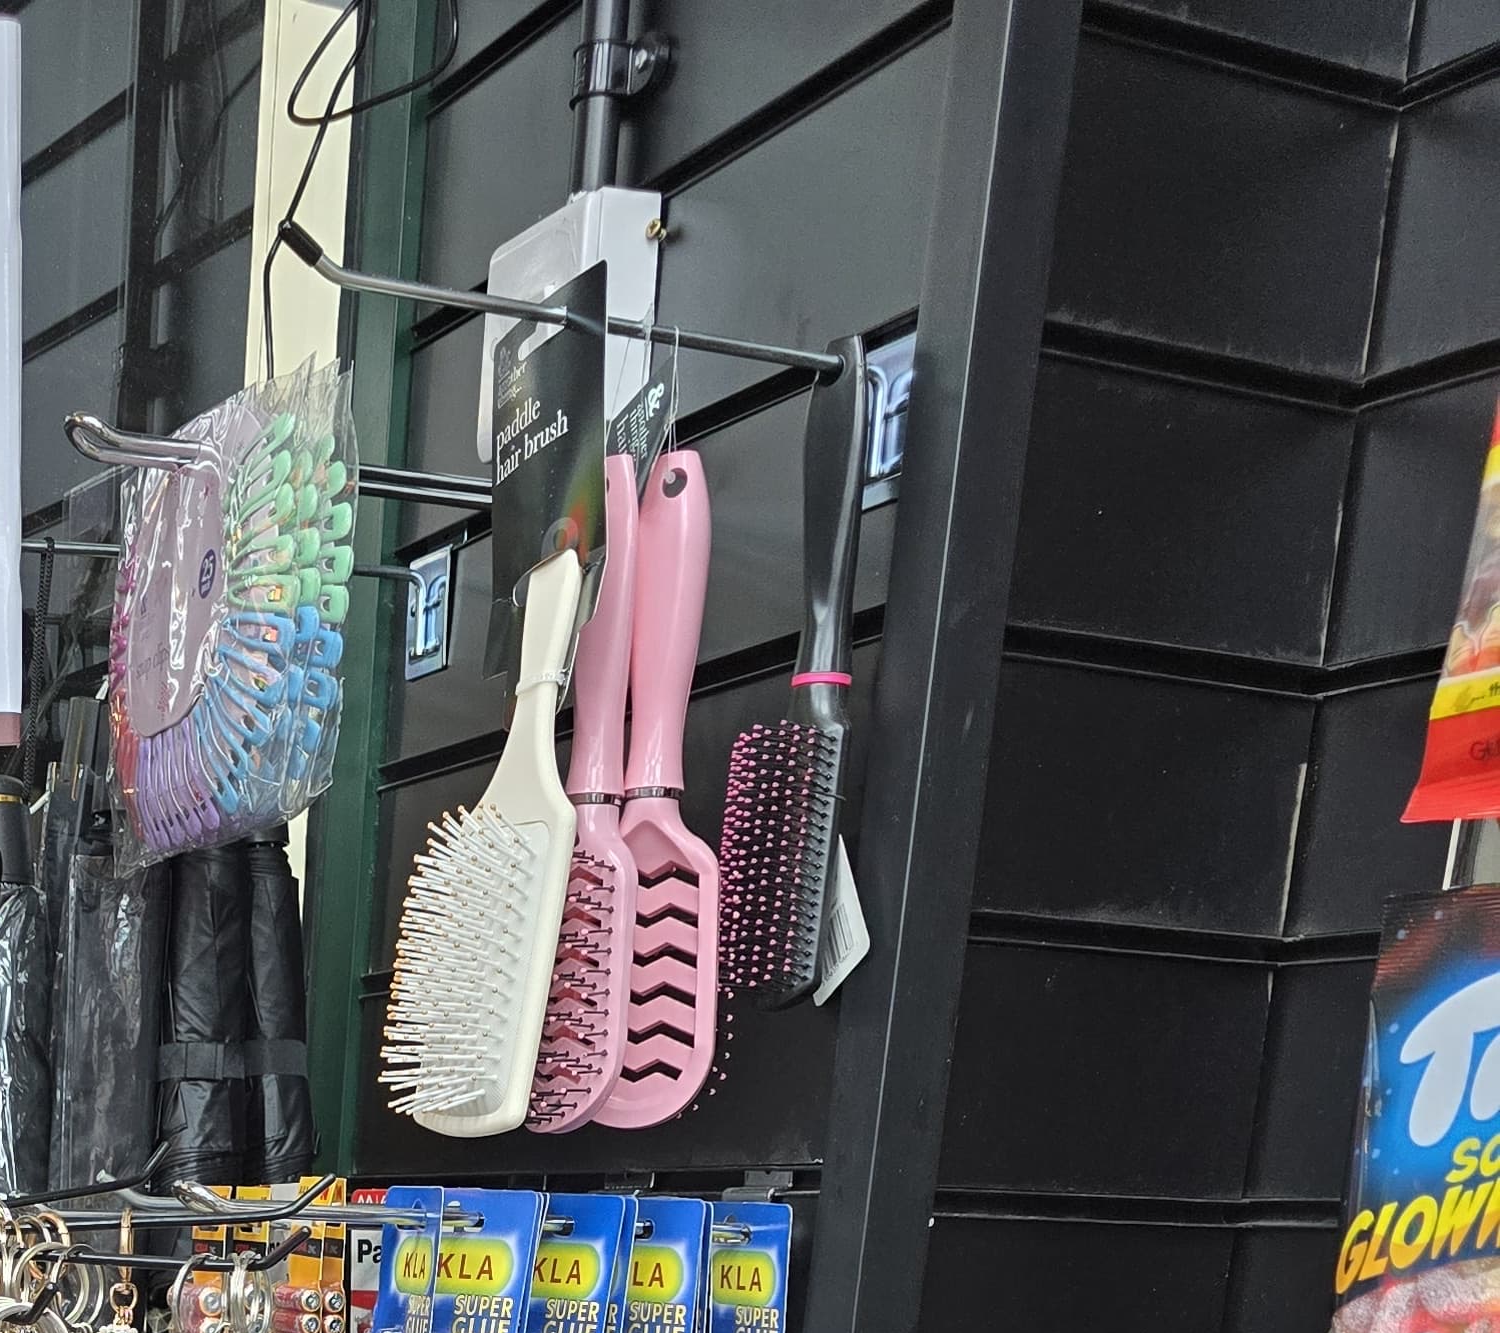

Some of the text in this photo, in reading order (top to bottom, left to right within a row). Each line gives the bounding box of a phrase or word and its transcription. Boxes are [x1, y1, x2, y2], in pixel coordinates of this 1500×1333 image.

[495, 397, 541, 452] paddle
[495, 408, 569, 487] hair brush
[403, 1252, 426, 1280] KLA
[437, 1251, 494, 1281] KLA
[532, 1257, 582, 1286] KLA
[631, 1261, 665, 1289] LA
[719, 1264, 762, 1292] KLA
[407, 1295, 431, 1317] SUPER
[453, 1294, 515, 1319] SUPER
[544, 1298, 600, 1322] SUPER
[628, 1301, 687, 1326] SUPER
[734, 1304, 780, 1329] SUPER
